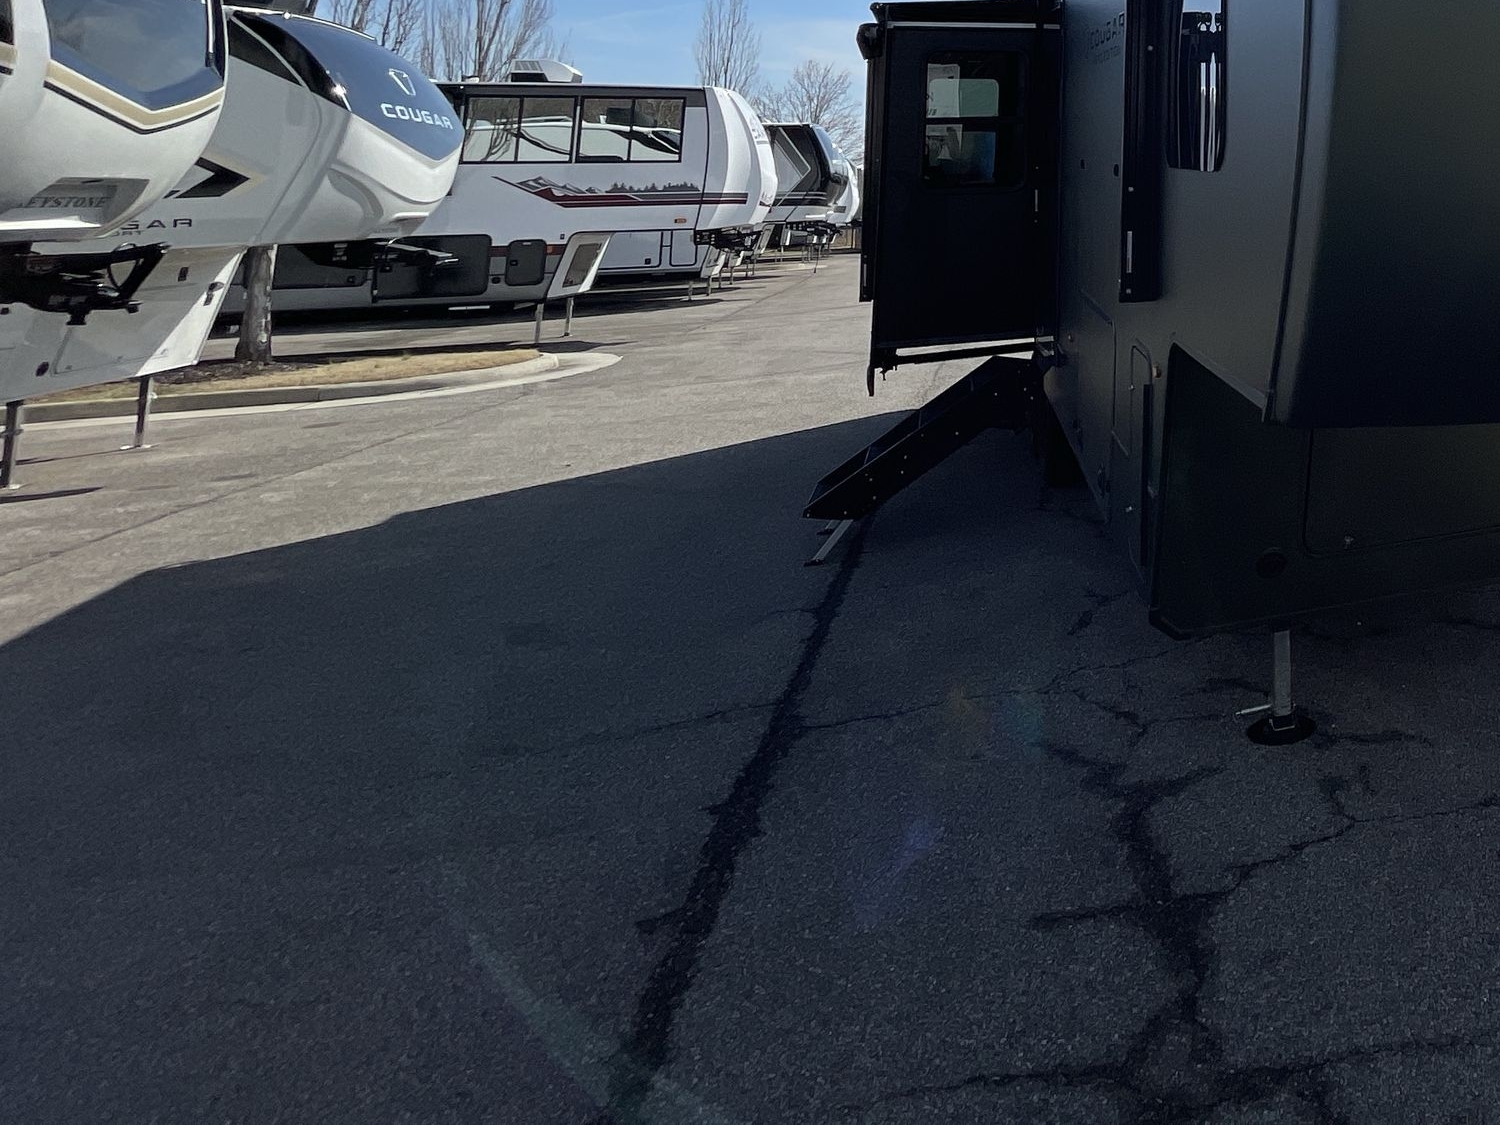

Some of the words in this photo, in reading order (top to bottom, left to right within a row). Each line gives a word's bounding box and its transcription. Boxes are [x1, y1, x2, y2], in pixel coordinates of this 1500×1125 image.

[380, 103, 454, 130] COUGAR
[16, 196, 112, 208] EYSTONE
[120, 218, 192, 230] GAR
